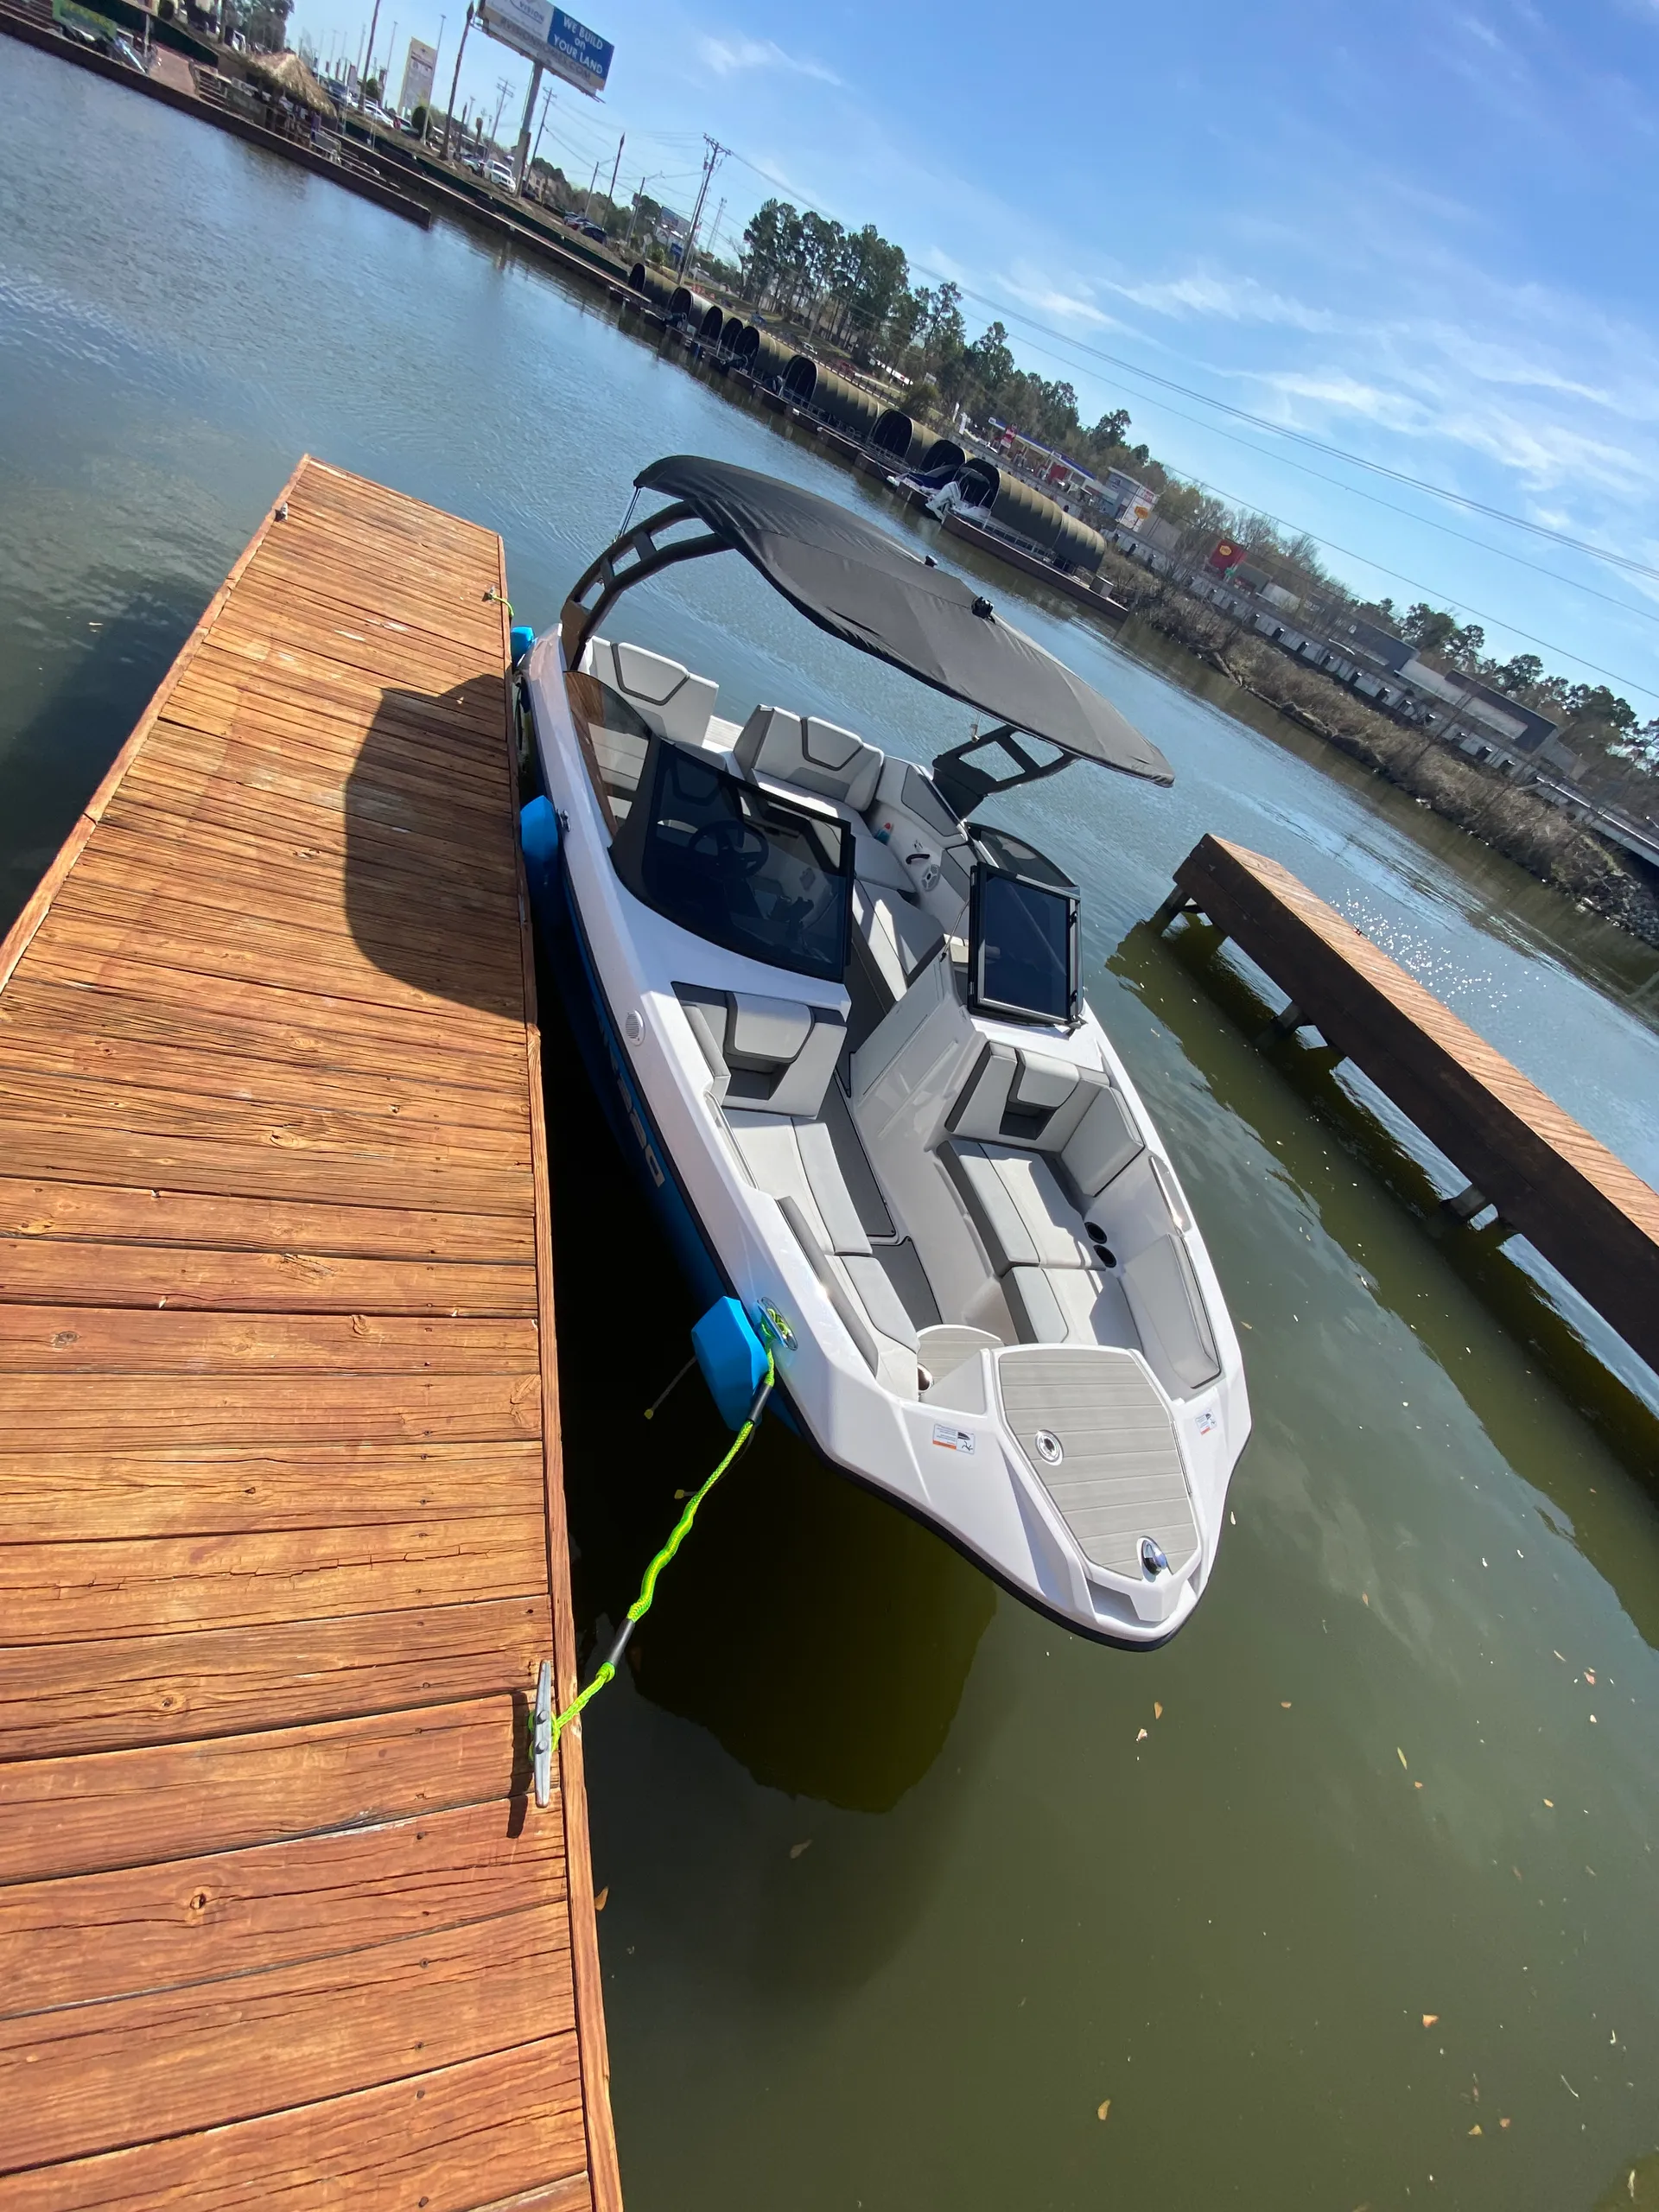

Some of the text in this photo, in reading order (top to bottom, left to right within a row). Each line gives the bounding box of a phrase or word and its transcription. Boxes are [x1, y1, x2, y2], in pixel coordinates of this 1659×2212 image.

[519, 1, 545, 22] VISION
[563, 16, 576, 34] WE
[579, 26, 603, 50] BUILD
[574, 37, 586, 50] on
[554, 34, 603, 74] YOUR LAND
